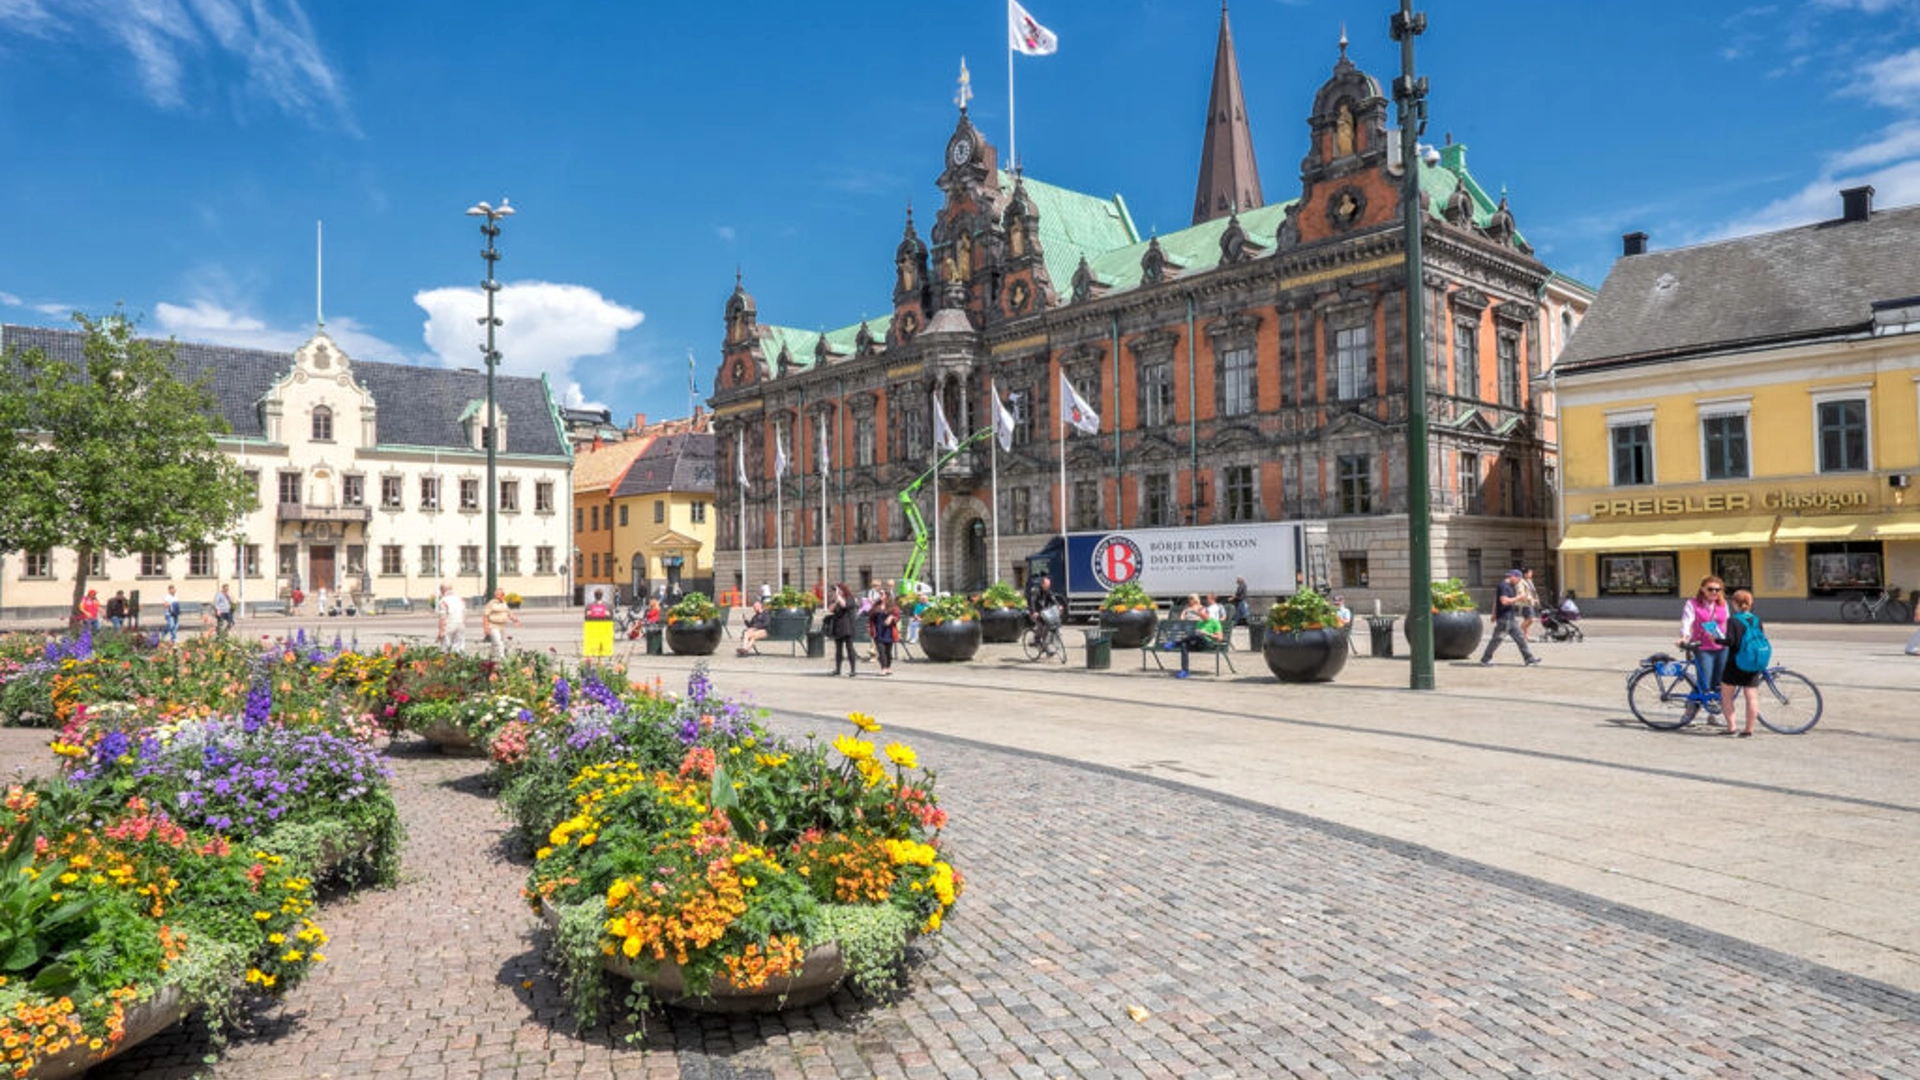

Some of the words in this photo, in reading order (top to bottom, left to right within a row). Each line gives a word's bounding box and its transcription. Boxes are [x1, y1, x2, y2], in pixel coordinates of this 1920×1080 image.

[1590, 492, 1750, 517] PREISLER
[1762, 488, 1867, 510] Glasögon
[1150, 541, 1182, 552] BÖRJE
[1188, 538, 1257, 550] BENGTSSON
[1107, 544, 1135, 582] B
[1150, 553, 1234, 564] DISTRIBUTION
